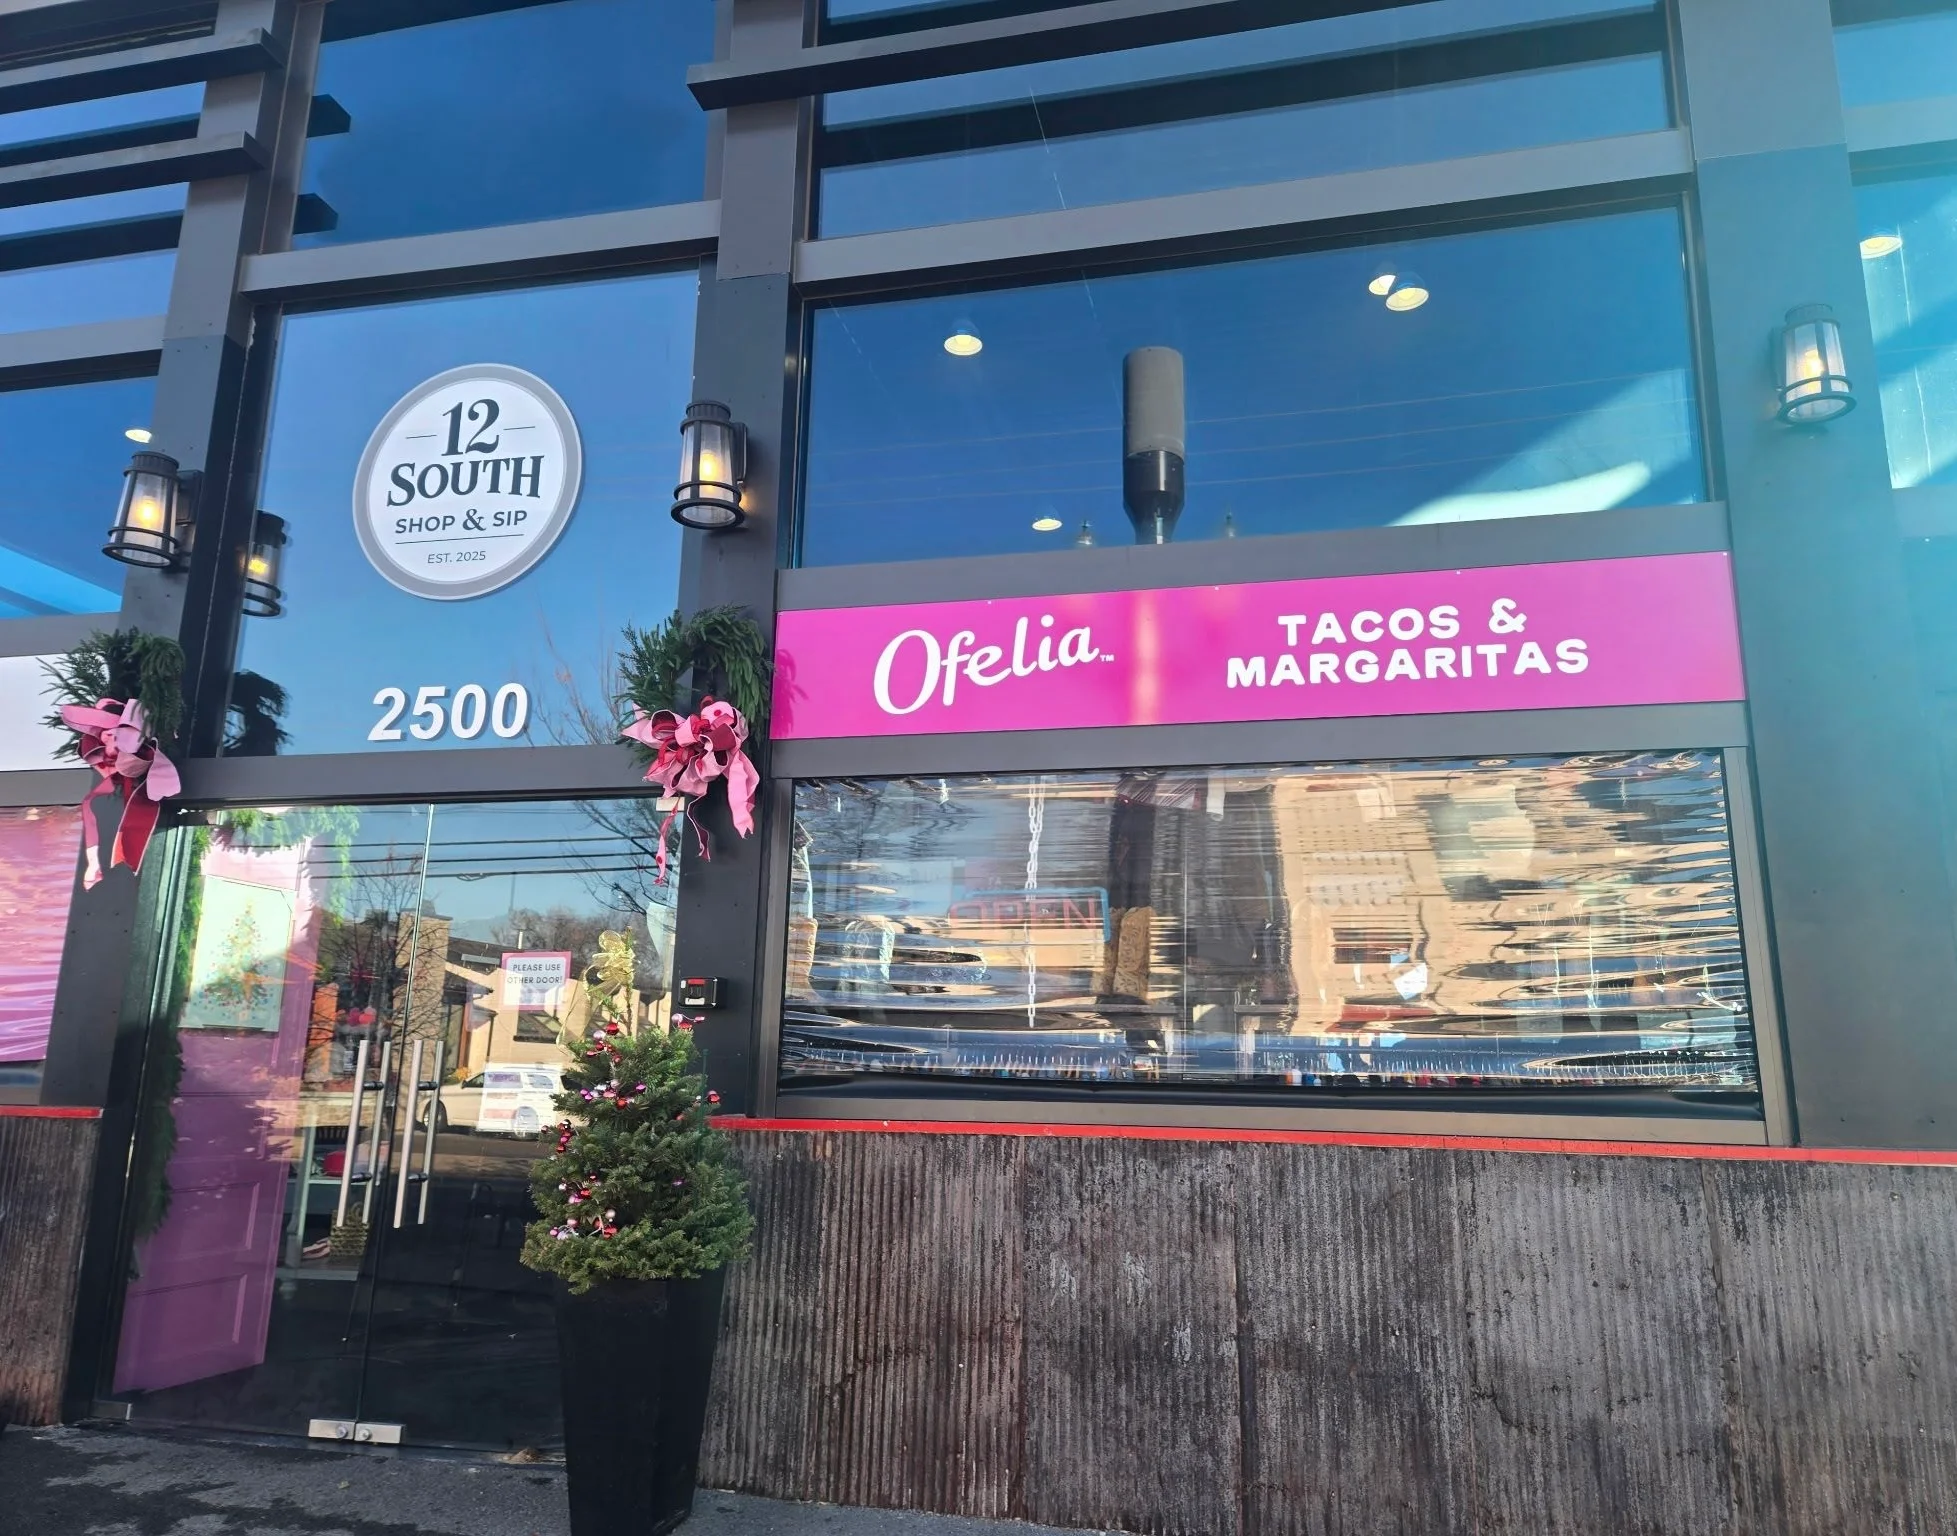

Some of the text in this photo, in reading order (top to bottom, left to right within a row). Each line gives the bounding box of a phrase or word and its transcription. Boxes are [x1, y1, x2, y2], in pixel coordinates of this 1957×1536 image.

[441, 398, 500, 457] 12
[386, 455, 545, 507] SOUTH
[395, 508, 528, 535] SHOP & SIP
[427, 550, 486, 565] EST. 2025
[1277, 597, 1528, 647] TACOS &
[873, 614, 1099, 715] Ofelia
[1226, 638, 1589, 689] MARGARITAS
[367, 682, 529, 742] 2500
[948, 894, 1098, 933] OPEN
[508, 976, 533, 984] OTHER
[512, 963, 561, 971] PLEASE USE
